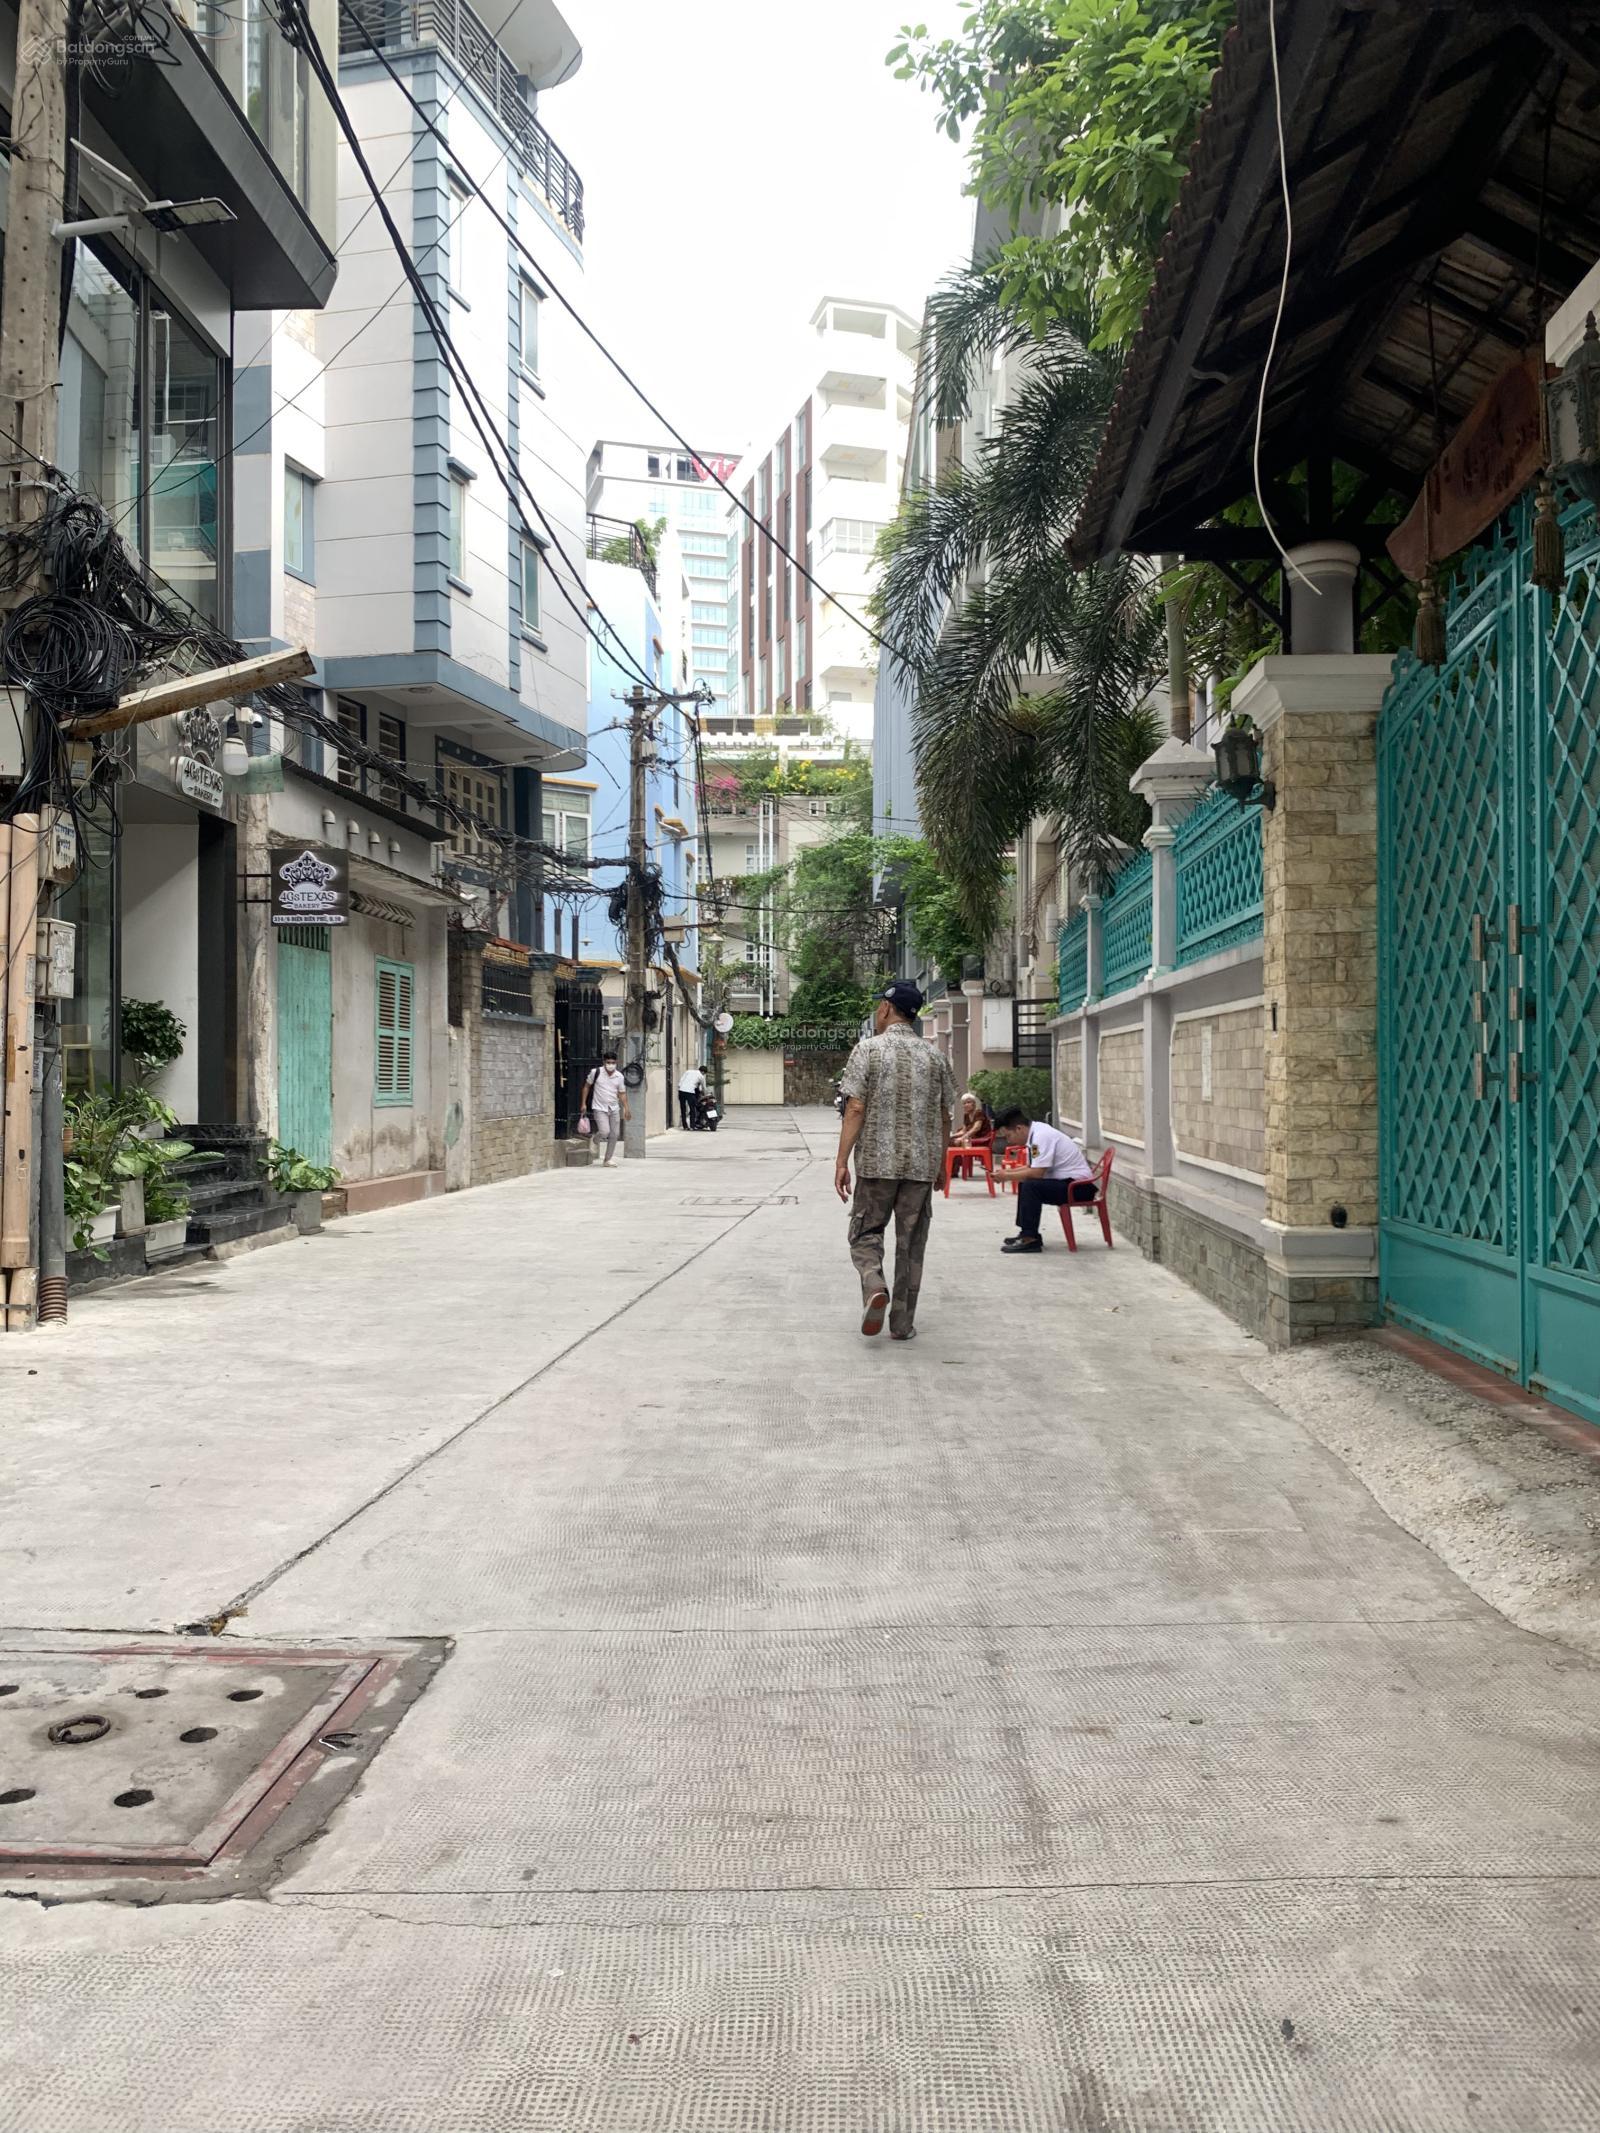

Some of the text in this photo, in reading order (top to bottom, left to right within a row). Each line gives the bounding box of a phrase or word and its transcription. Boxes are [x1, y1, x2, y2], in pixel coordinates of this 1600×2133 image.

[184, 761, 223, 793] 4GsTEXAS
[193, 785, 214, 801] BAKERY
[280, 891, 335, 902] 4GsTEXAS
